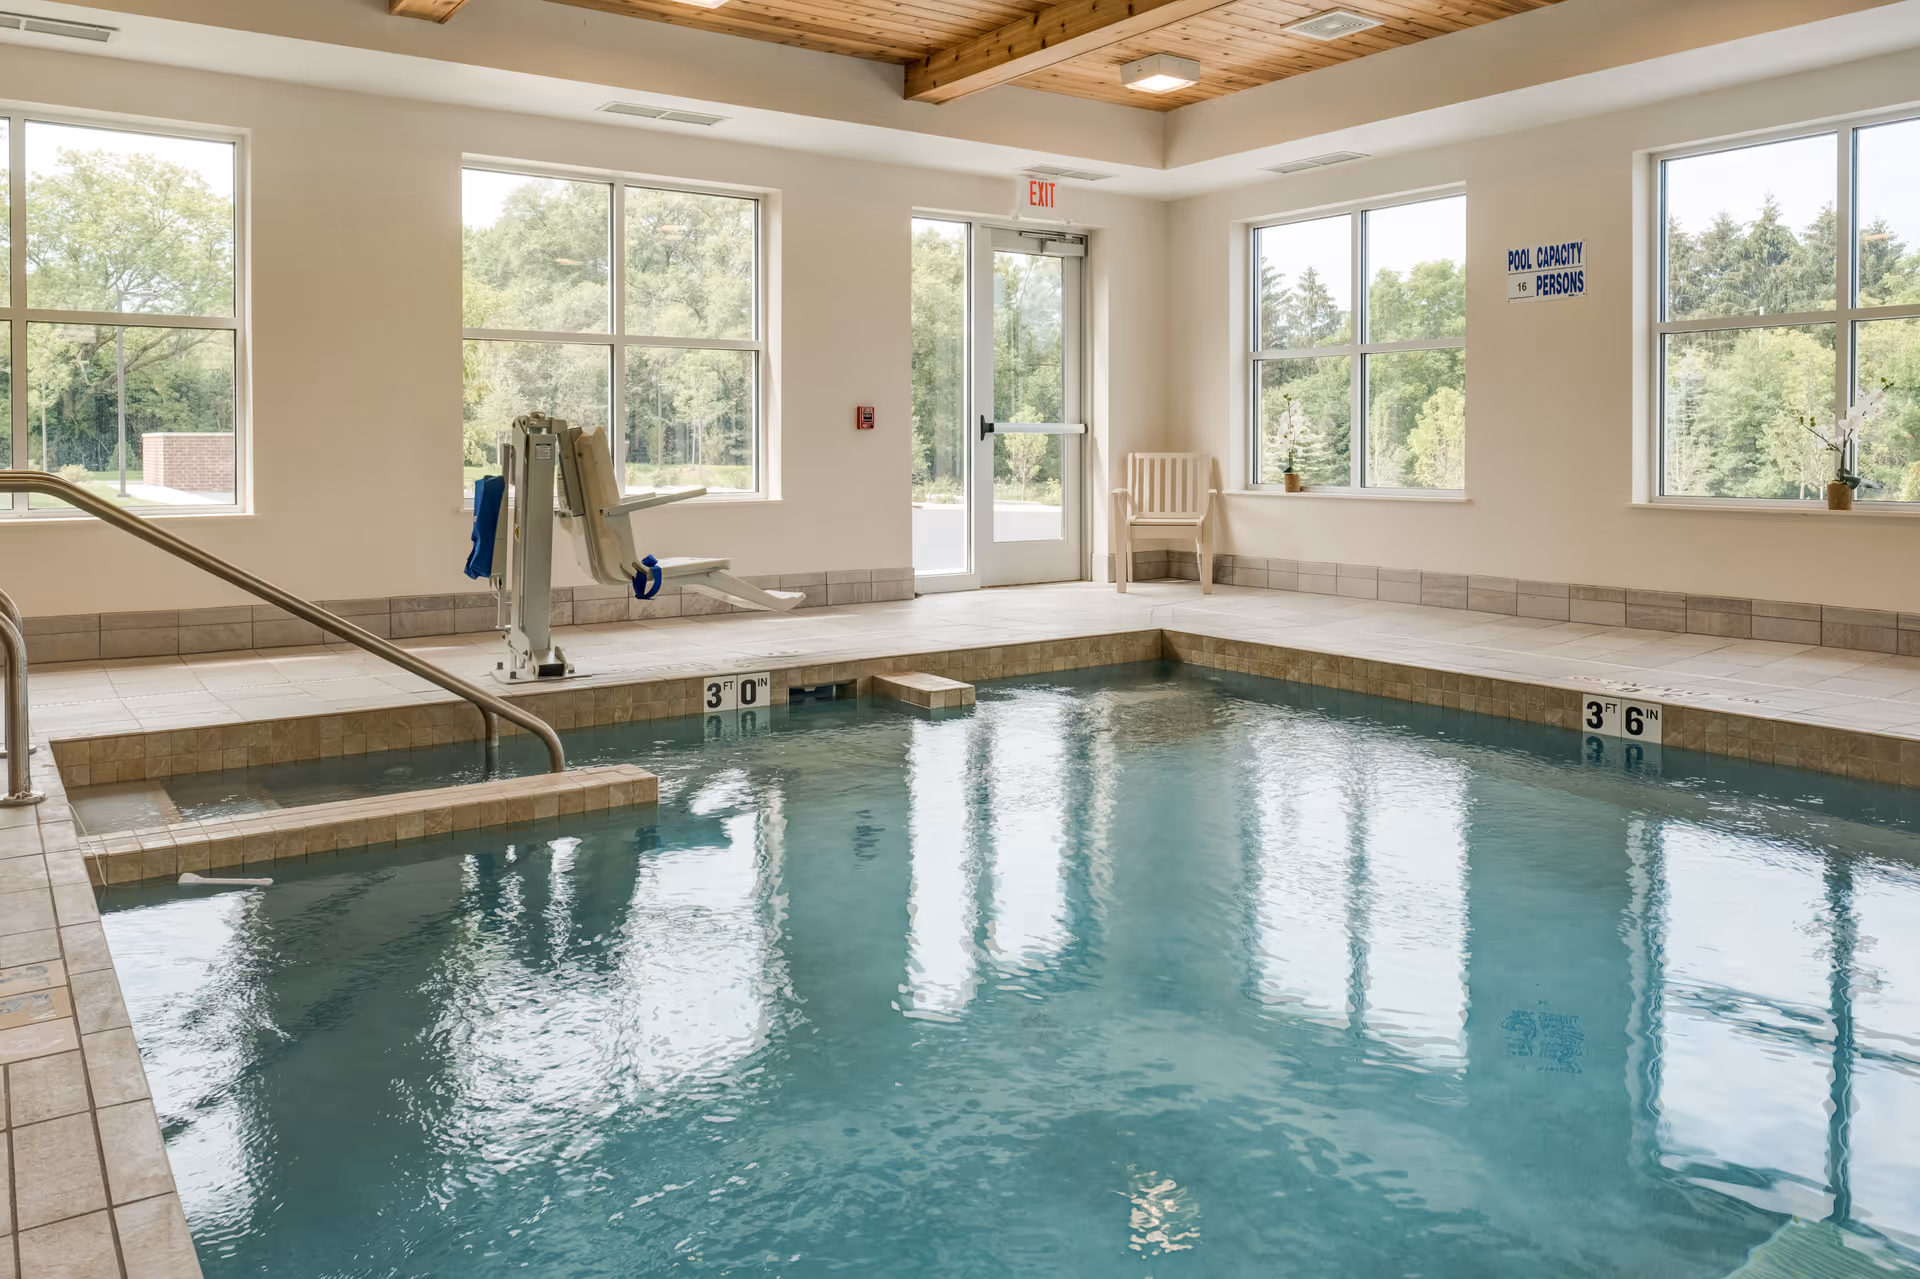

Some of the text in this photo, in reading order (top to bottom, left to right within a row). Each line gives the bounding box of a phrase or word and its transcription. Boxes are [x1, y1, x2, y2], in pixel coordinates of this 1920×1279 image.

[1030, 180, 1056, 208] EXIT
[1508, 242, 1583, 271] POOL CAPACITY
[1517, 270, 1584, 296] 16 PERSONS
[706, 683, 722, 708] 3
[723, 681, 734, 690] FT
[757, 678, 768, 687] IN
[1586, 701, 1658, 736] 3 FT 6 IN
